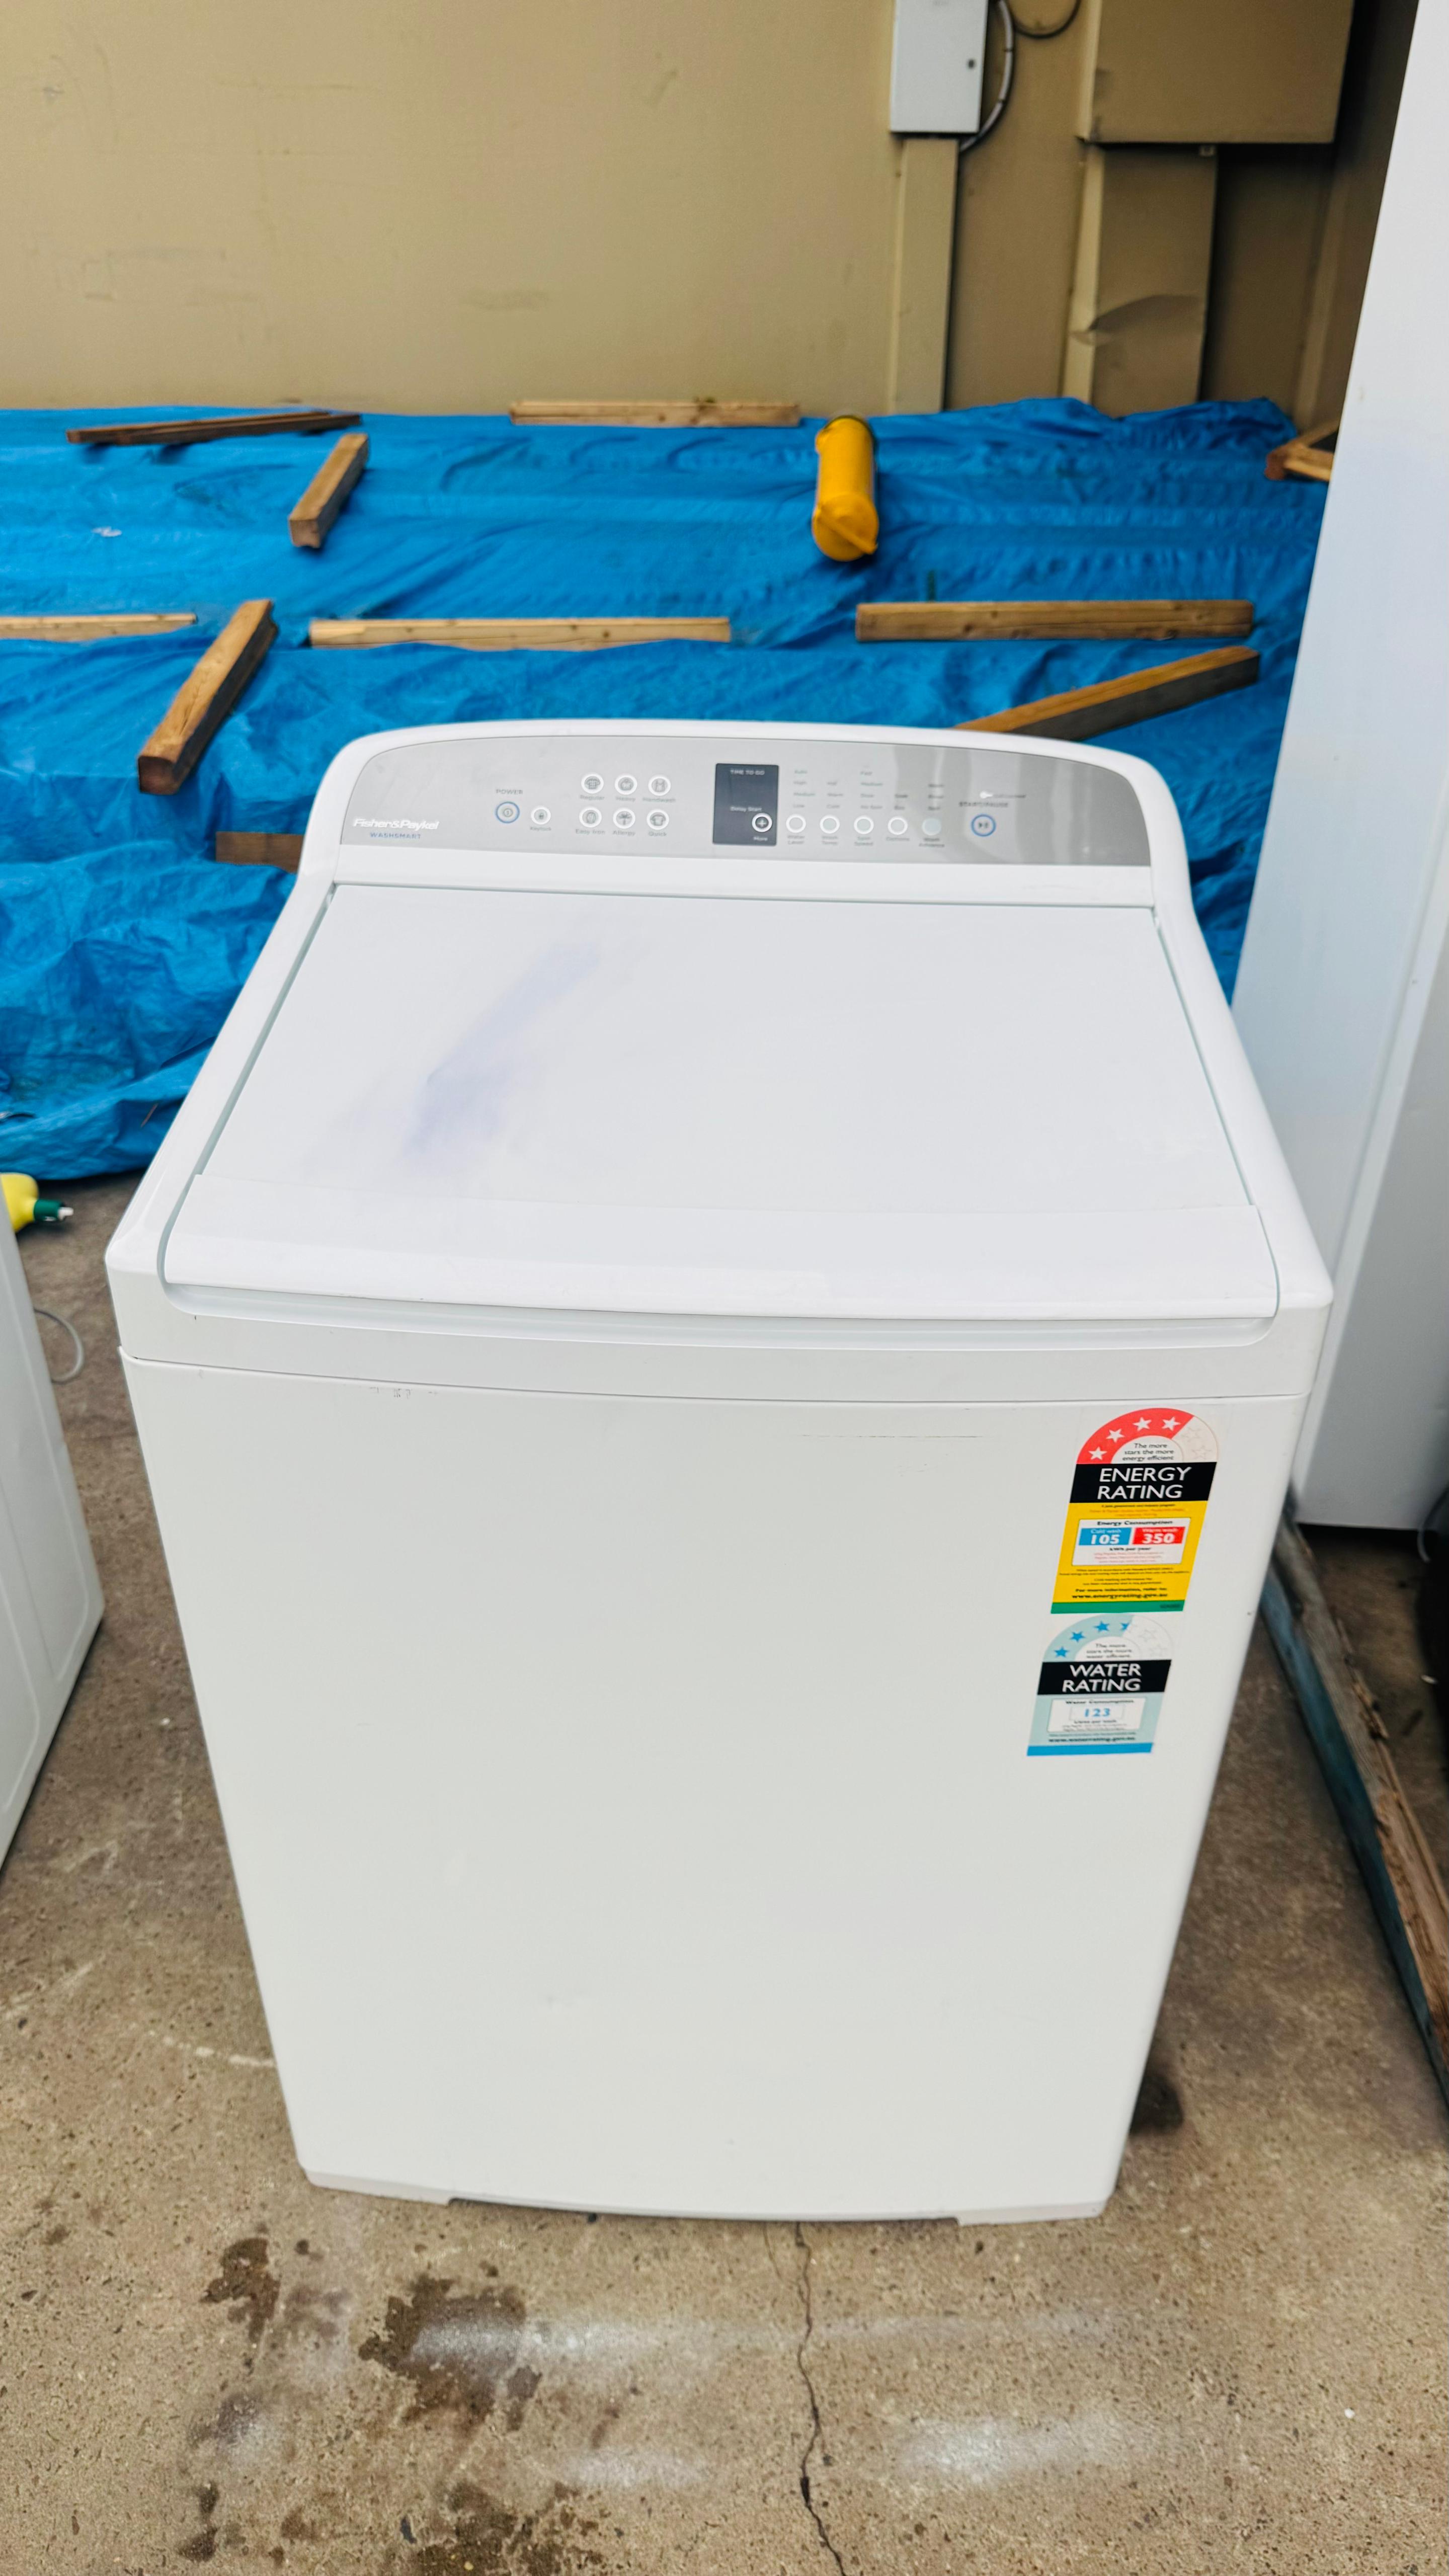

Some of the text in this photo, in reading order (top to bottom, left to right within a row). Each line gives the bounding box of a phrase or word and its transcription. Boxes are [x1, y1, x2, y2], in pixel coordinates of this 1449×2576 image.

[353, 819, 440, 831] Fisher&Paykel
[370, 832, 421, 840] WASHSMART
[1099, 1467, 1192, 1482] ENERGY
[1097, 1484, 1183, 1499] RATING
[1091, 1534, 1120, 1545] 105
[1142, 1533, 1175, 1544] 350
[1070, 1663, 1142, 1677] WATER
[1062, 1678, 1142, 1693] RATING
[1084, 1708, 1111, 1718] 123
